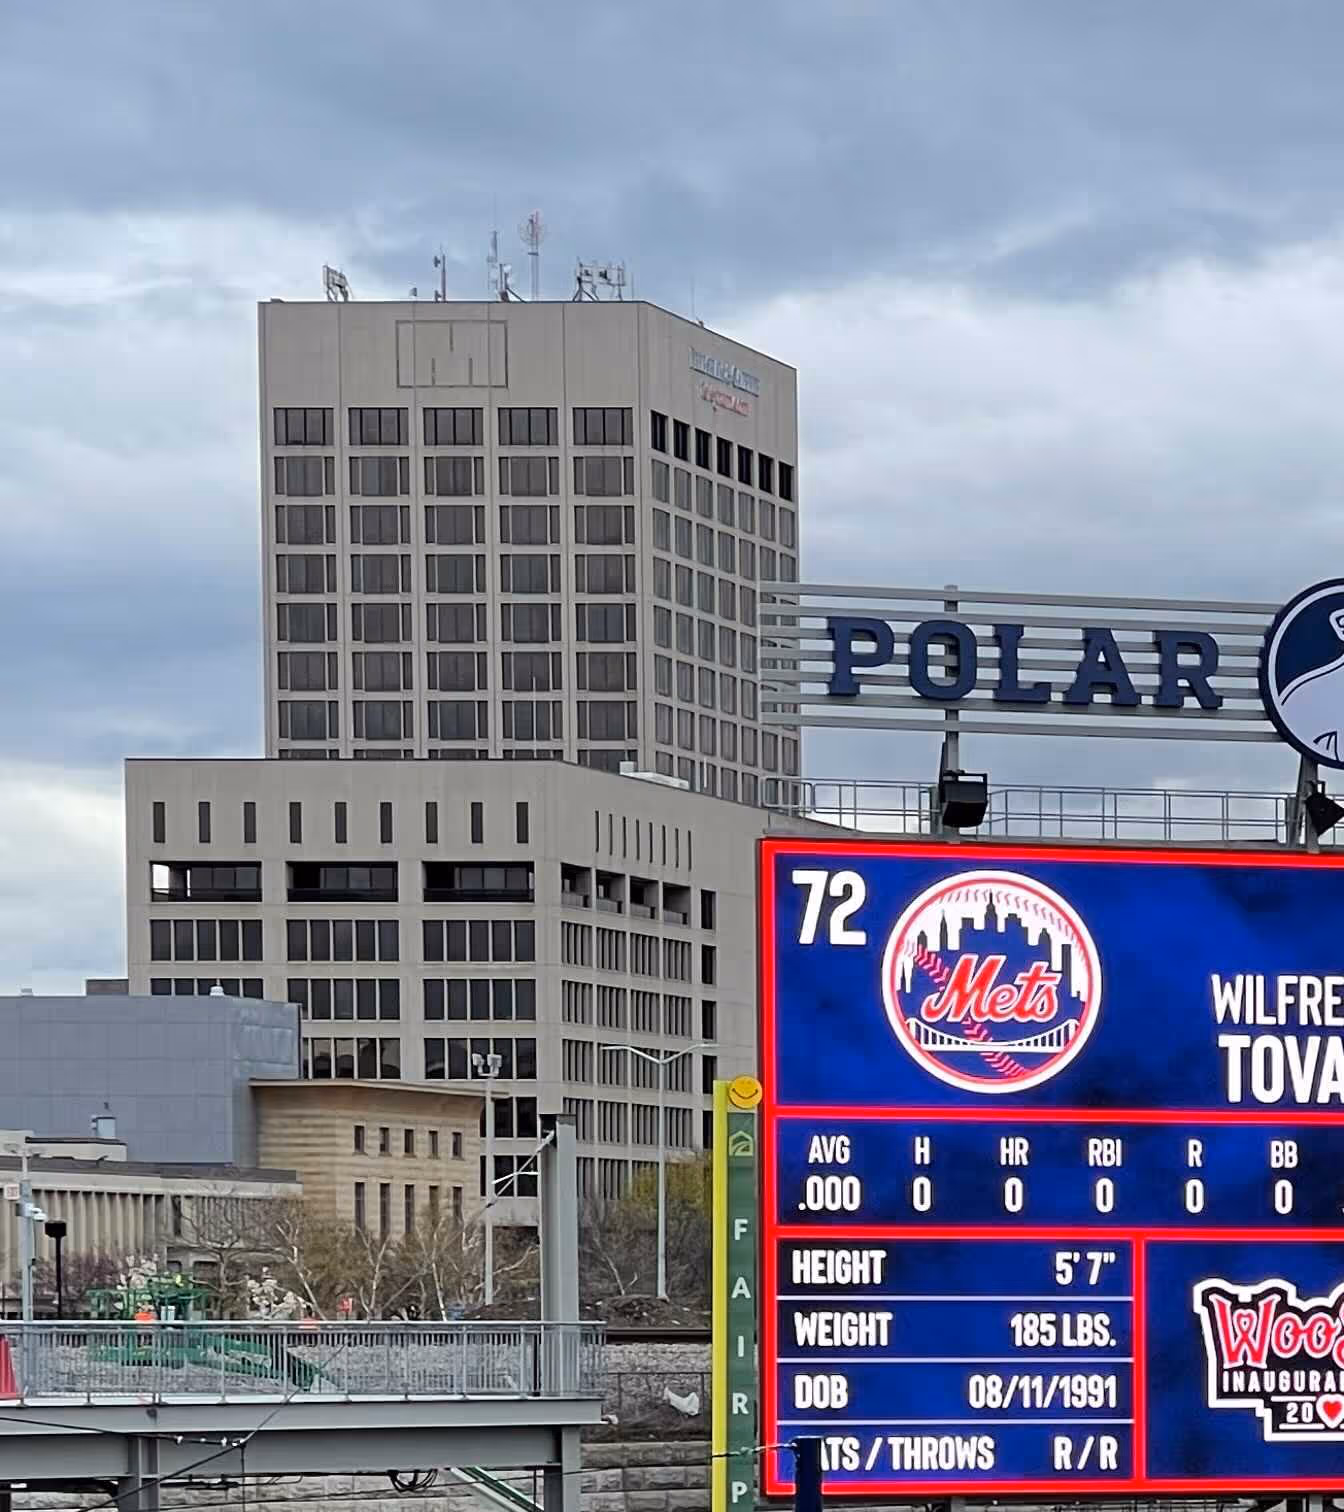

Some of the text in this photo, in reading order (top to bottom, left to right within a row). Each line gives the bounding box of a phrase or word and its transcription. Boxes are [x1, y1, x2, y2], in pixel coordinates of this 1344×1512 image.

[827, 615, 1223, 709] POLAR
[792, 869, 867, 945] 72
[921, 952, 1062, 1022] Mets
[808, 1134, 850, 1165] AVG
[915, 1136, 930, 1165] H
[1000, 1137, 1029, 1166] HR
[1088, 1138, 1122, 1167] RBI
[1188, 1139, 1203, 1167] R
[1270, 1140, 1298, 1169] BB
[798, 1175, 861, 1211] .000
[912, 1176, 931, 1212] 0
[1004, 1177, 1023, 1213] 0
[1095, 1177, 1114, 1213] 0
[1185, 1179, 1204, 1214] 0
[1274, 1179, 1293, 1215] 0
[792, 1249, 887, 1285] HEIGHT
[730, 1218, 752, 1415] FAIR
[794, 1311, 1117, 1347] WEIGHT 185 LBS.
[794, 1374, 1117, 1409] DOB 08/11/1991
[820, 1436, 860, 1471] TS
[887, 1435, 995, 1471] THROWS
